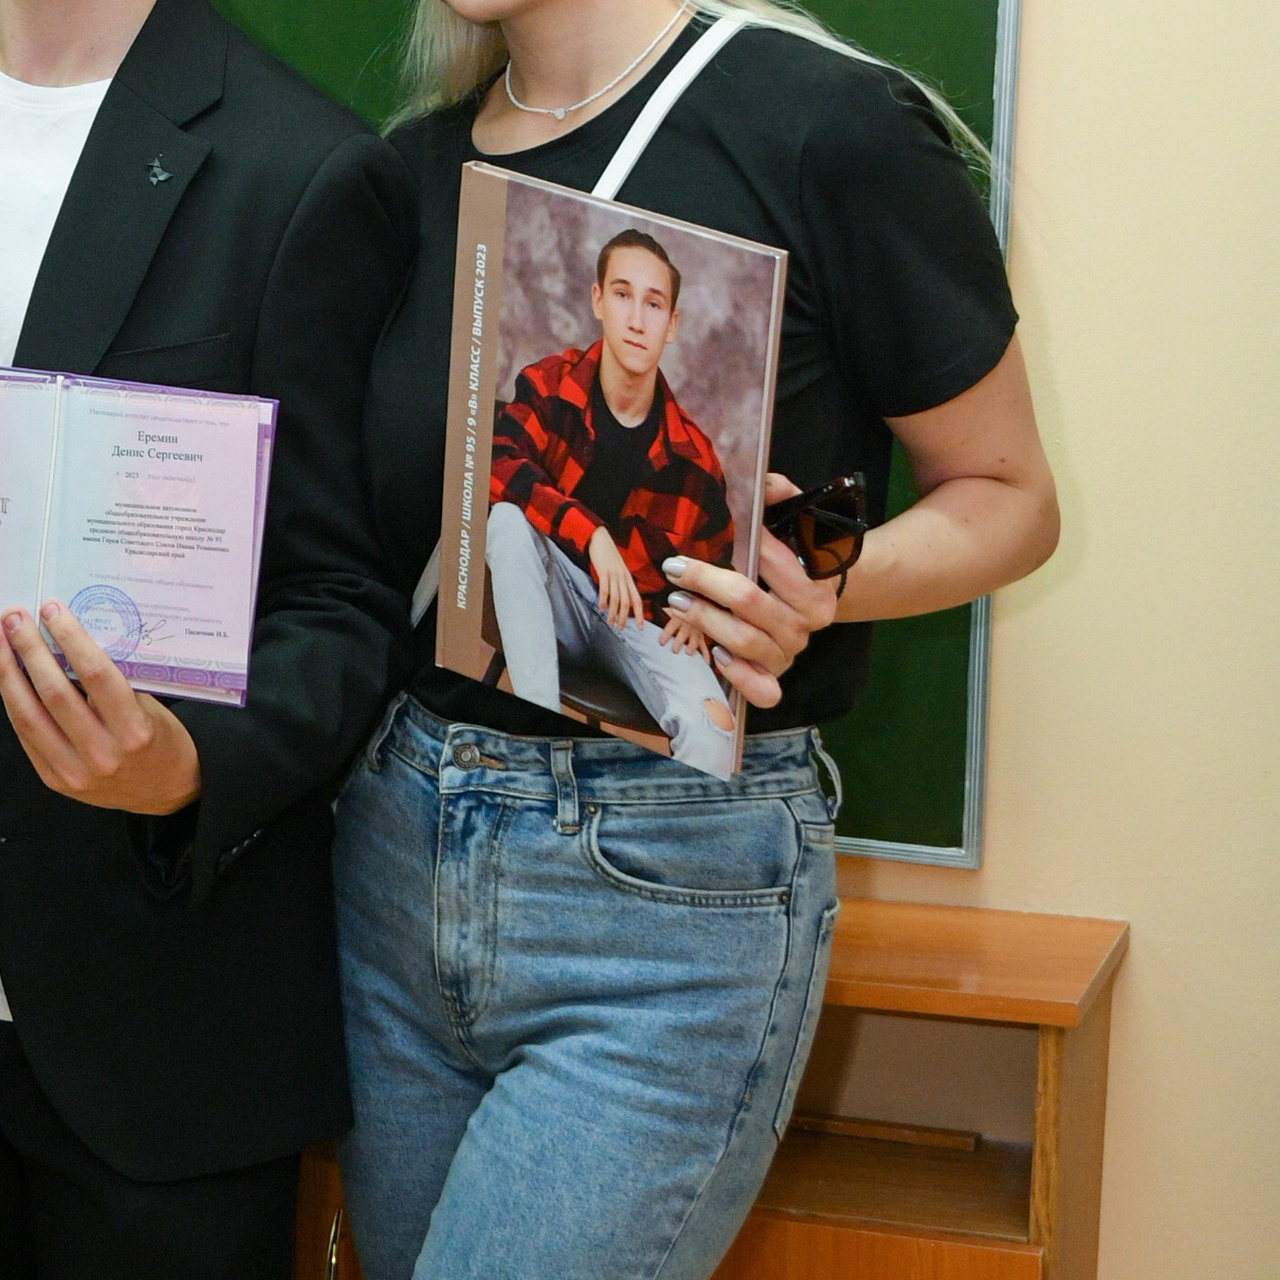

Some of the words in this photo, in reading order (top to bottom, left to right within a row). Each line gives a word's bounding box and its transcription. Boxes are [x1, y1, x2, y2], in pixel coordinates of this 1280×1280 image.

[475, 243, 487, 277] 2023
[472, 278, 485, 337] ВЫПУСК
[469, 346, 481, 391] КЛАСС
[468, 417, 477, 426] 9
[137, 430, 178, 444] Еремин
[466, 436, 476, 452] 95
[111, 445, 145, 458] Денис
[147, 447, 203, 462] Сергеевич
[465, 453, 475, 469] №
[124, 471, 139, 479] 2023
[462, 473, 474, 521] ШКОЛА
[457, 530, 471, 609] КРАСНОДАР
